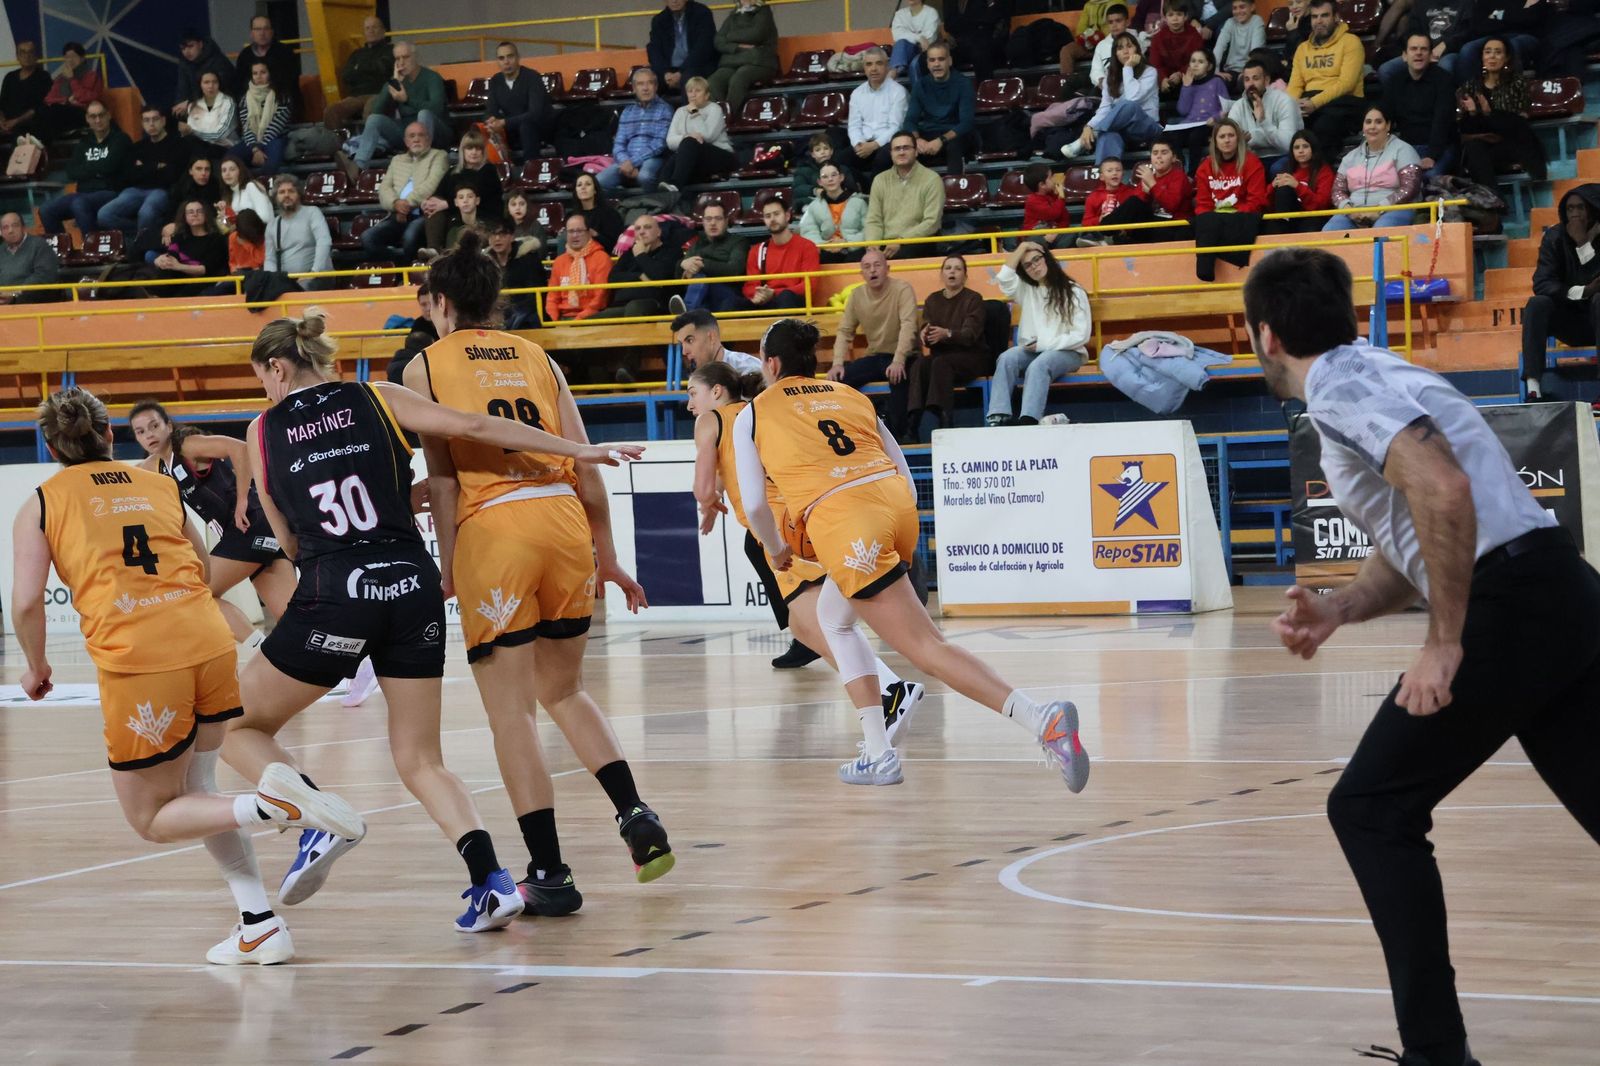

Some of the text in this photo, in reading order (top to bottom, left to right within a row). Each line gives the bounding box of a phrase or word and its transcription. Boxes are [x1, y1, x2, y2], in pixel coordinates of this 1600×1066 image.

[1305, 53, 1334, 69] VANS
[998, 82, 1007, 94] 7
[822, 96, 829, 107] 1
[959, 178, 968, 189] 9
[465, 345, 519, 361] SÁNCHEZ
[286, 408, 355, 444] MARTÍNEZ
[818, 419, 856, 456] 8
[942, 458, 1058, 474] E.S. CAMINO DE LA PLATA
[90, 471, 133, 485] NISKI
[966, 477, 981, 489] 980
[984, 476, 999, 488] 570
[1001, 476, 1015, 488] 021
[309, 474, 379, 536] 30
[943, 491, 1044, 506] Morales del Vino (Zamora)
[122, 524, 159, 575] 4
[946, 542, 1064, 556] SERVICIO A DOMICILIO DE
[1096, 543, 1179, 563] RepoSTAR
[949, 562, 977, 572] Gasóleo
[979, 561, 987, 571] de
[1029, 563, 1033, 573] y
[1036, 560, 1064, 573] Agrícola
